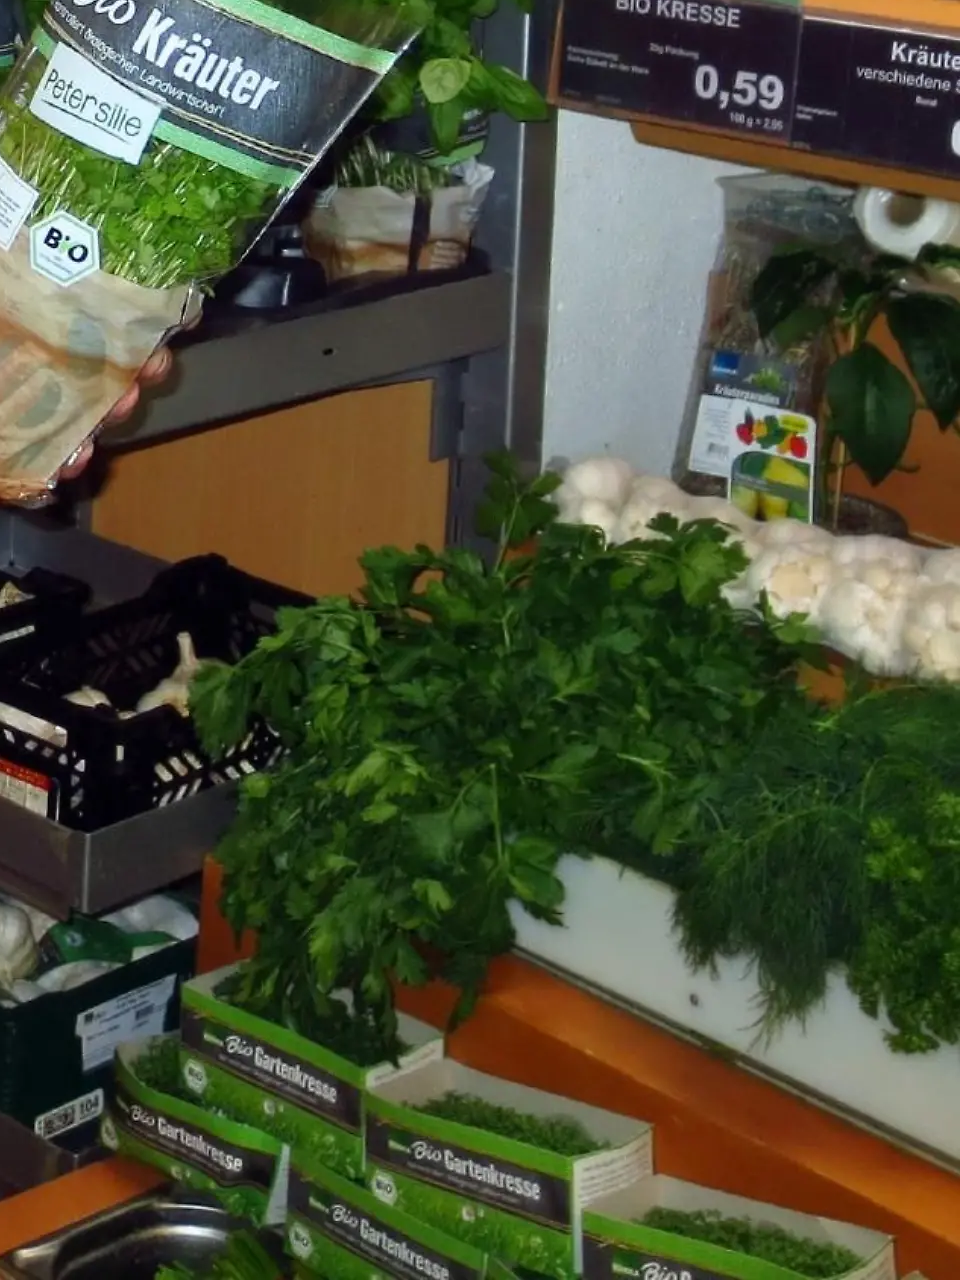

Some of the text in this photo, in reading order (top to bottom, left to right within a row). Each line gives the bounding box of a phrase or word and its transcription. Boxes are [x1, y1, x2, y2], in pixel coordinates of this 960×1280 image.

[132, 7, 280, 111] Kräuter
[694, 63, 785, 111] 0,59
[856, 66, 952, 93] verschiedene
[42, 68, 142, 137] Petersilie
[140, 69, 226, 119] Landwirtschaft
[225, 1035, 254, 1058] Bio
[253, 1046, 338, 1104] Gartenkresse
[130, 1104, 155, 1127] Bio
[157, 1116, 243, 1173] Gartenkresse
[410, 1140, 442, 1163] Bio
[443, 1149, 542, 1201] Gartenkresse
[331, 1203, 450, 1280] Bio Gartenkresse
